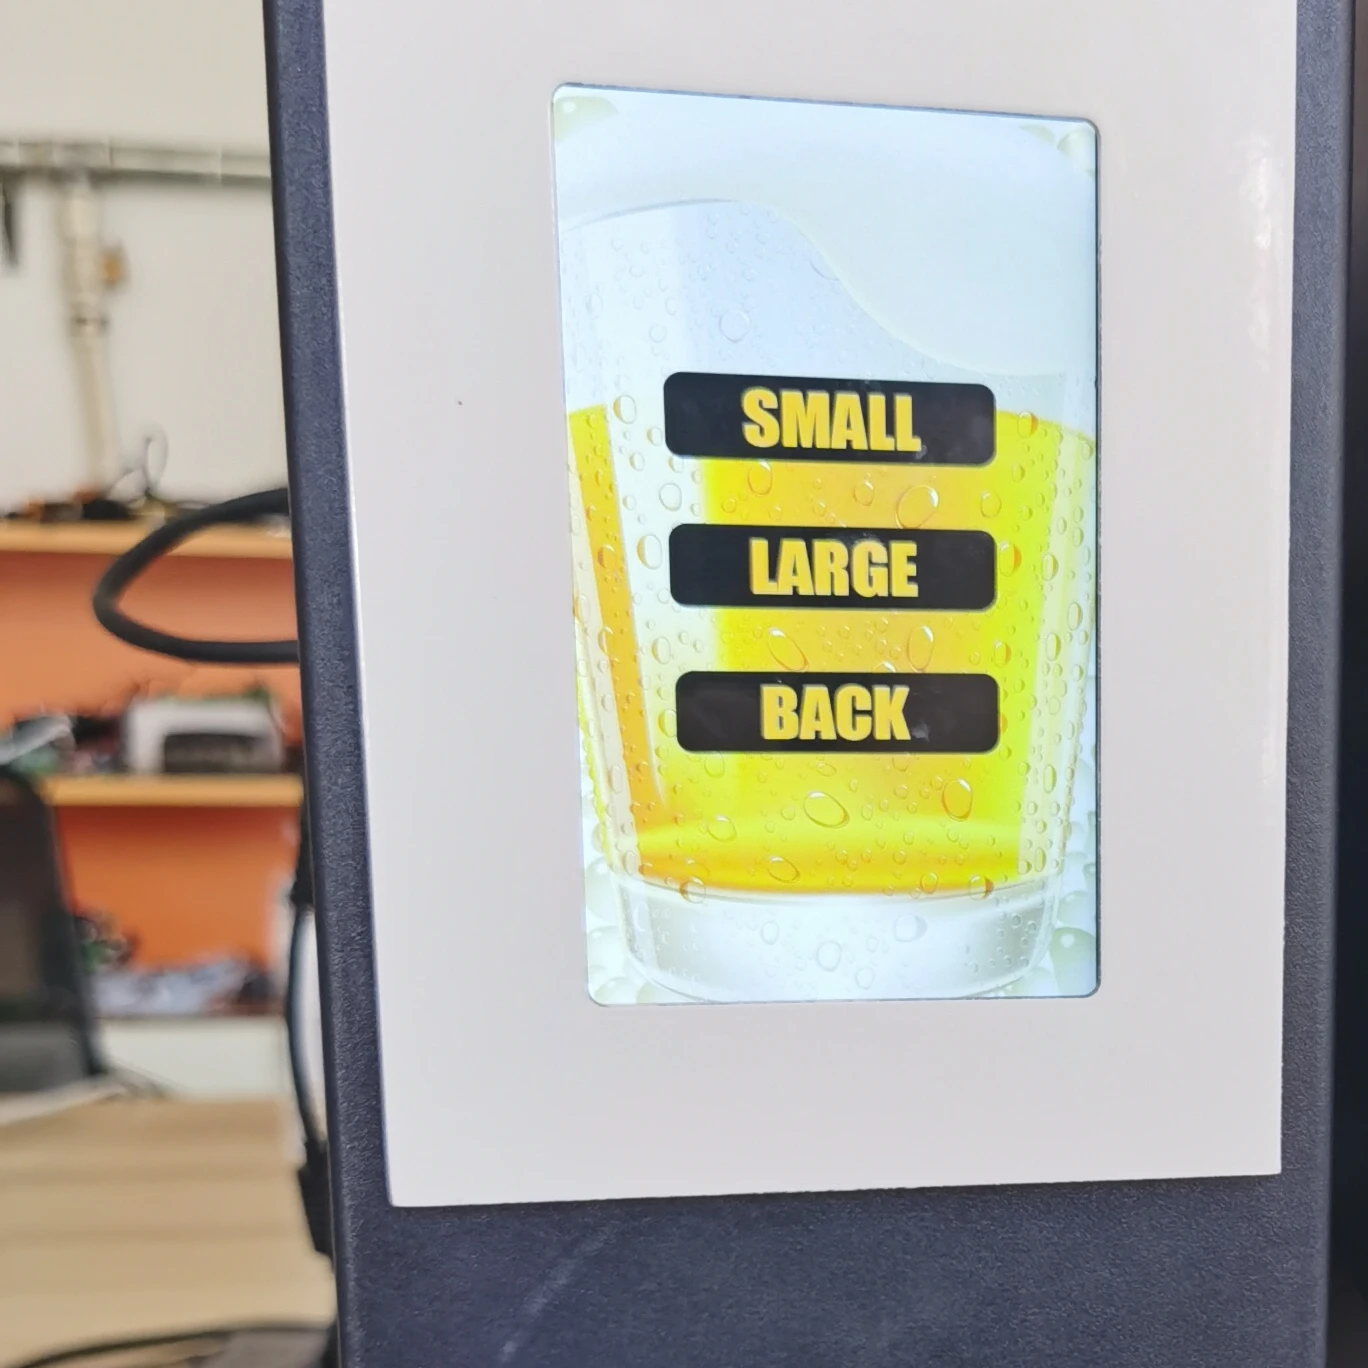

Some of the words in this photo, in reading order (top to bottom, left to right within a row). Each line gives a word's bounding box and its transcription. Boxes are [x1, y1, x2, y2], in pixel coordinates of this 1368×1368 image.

[741, 386, 922, 453] SMALL
[749, 538, 919, 598] LARGE
[759, 684, 912, 742] BACK
